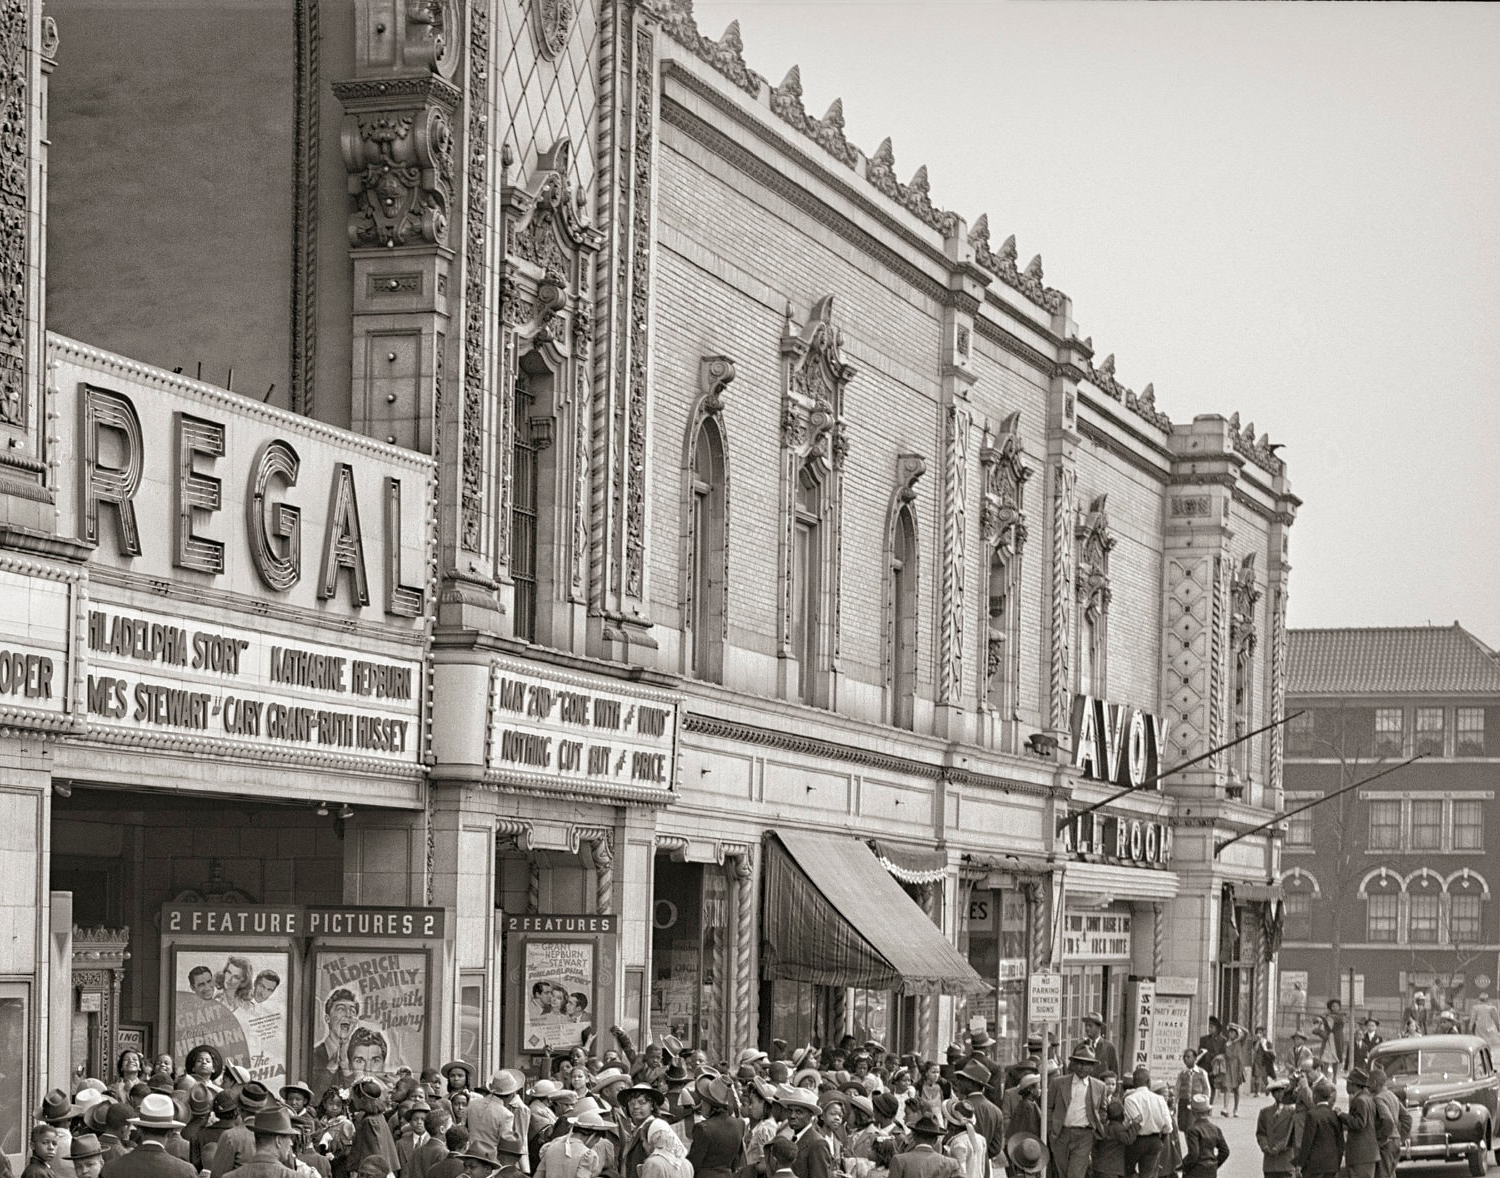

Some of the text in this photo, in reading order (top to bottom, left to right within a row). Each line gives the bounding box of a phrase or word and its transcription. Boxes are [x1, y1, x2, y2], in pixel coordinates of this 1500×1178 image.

[78, 382, 424, 617] REGAL
[271, 646, 347, 693] KATHARINE
[352, 660, 412, 700] HEPBURN
[134, 682, 211, 730] STEWART
[224, 695, 264, 736] CARY
[356, 715, 409, 752] HUSSEY
[500, 677, 528, 713] MAY
[594, 697, 621, 730] WITH
[502, 729, 552, 768] NOTHING
[558, 739, 584, 772] CUT
[587, 744, 612, 775] BUT
[631, 751, 667, 783] PRICE
[1074, 695, 1169, 790] AVOY
[1117, 817, 1173, 863] ROOM
[170, 911, 434, 935] 2 FEATURE PICTURES 2
[509, 918, 610, 931] 2 FEATURES
[323, 956, 347, 974] THE
[329, 954, 400, 990] ALDRICH
[546, 950, 583, 959] HEPBURN
[549, 959, 588, 967] STEWART
[380, 1009, 425, 1033] Henry
